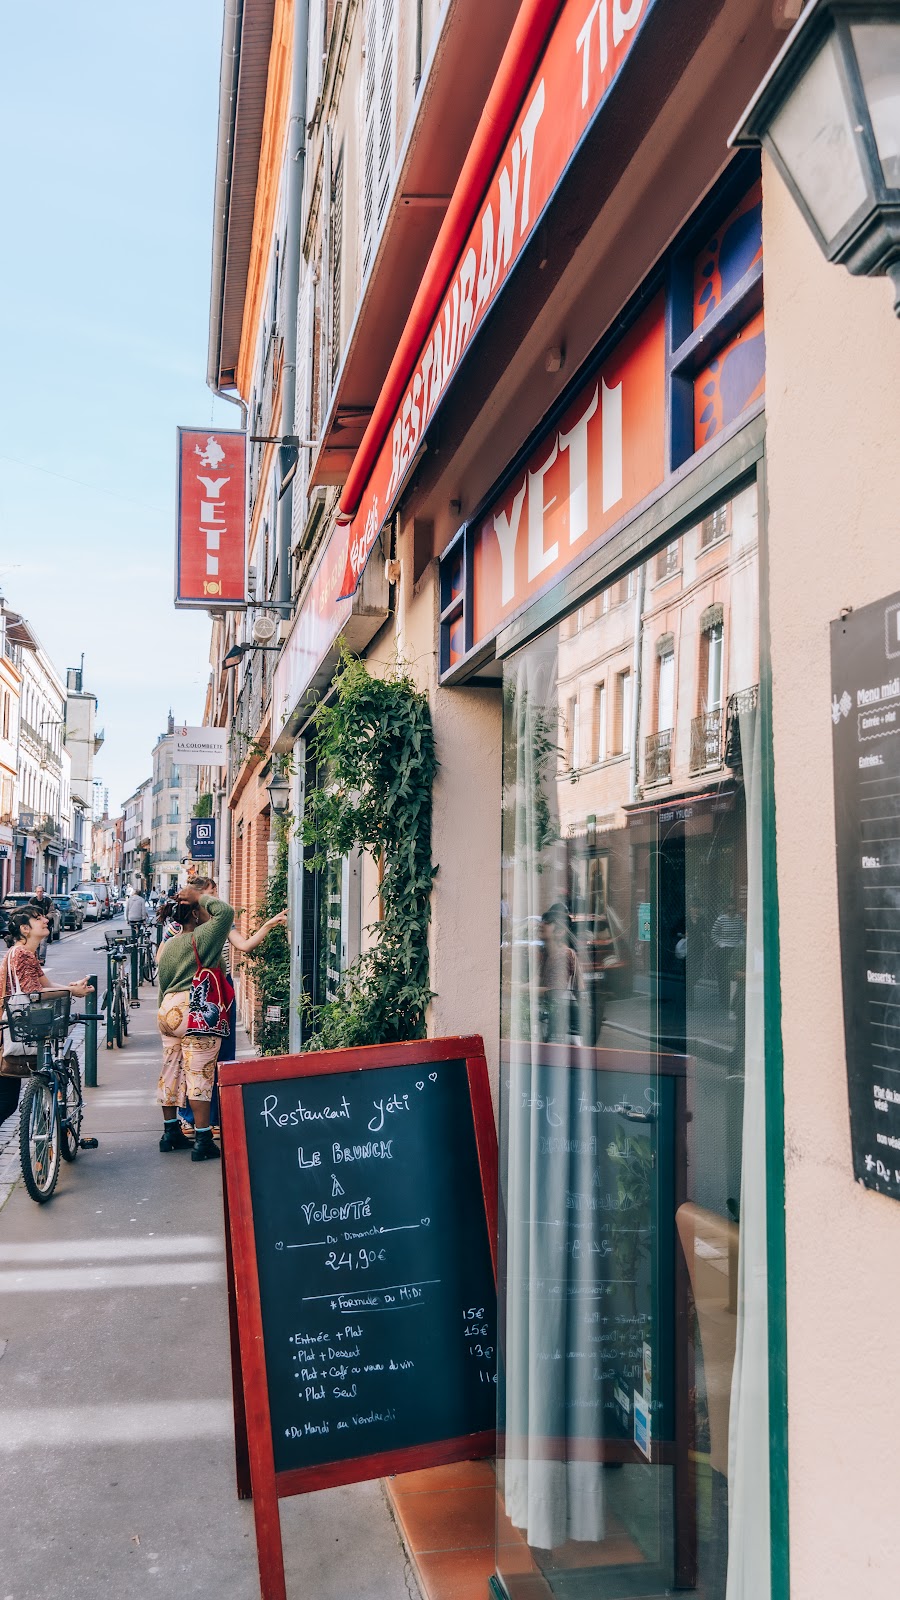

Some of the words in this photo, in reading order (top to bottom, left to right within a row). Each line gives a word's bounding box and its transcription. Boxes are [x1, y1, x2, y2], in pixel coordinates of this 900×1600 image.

[385, 77, 545, 504] RESTAURANT
[493, 376, 622, 607] YETI
[196, 475, 231, 576] YETI
[857, 688, 880, 705] Menu
[260, 1095, 351, 1127] Restaurant
[344, 1226, 385, 1241] Dimanche
[325, 1249, 386, 1271] 24,90€
[462, 1307, 485, 1320] 15€
[295, 1331, 331, 1345] Entrée
[345, 1325, 364, 1338] Plat
[464, 1323, 489, 1336] 15€
[298, 1349, 316, 1362] Plat
[328, 1345, 361, 1360] Dessert
[469, 1344, 494, 1359] 13€
[301, 1367, 318, 1381] Plat
[329, 1365, 349, 1380] Café
[400, 1359, 415, 1369] vin
[305, 1385, 326, 1402] Plat
[304, 1420, 330, 1435] Mardi
[337, 1420, 349, 1429] au
